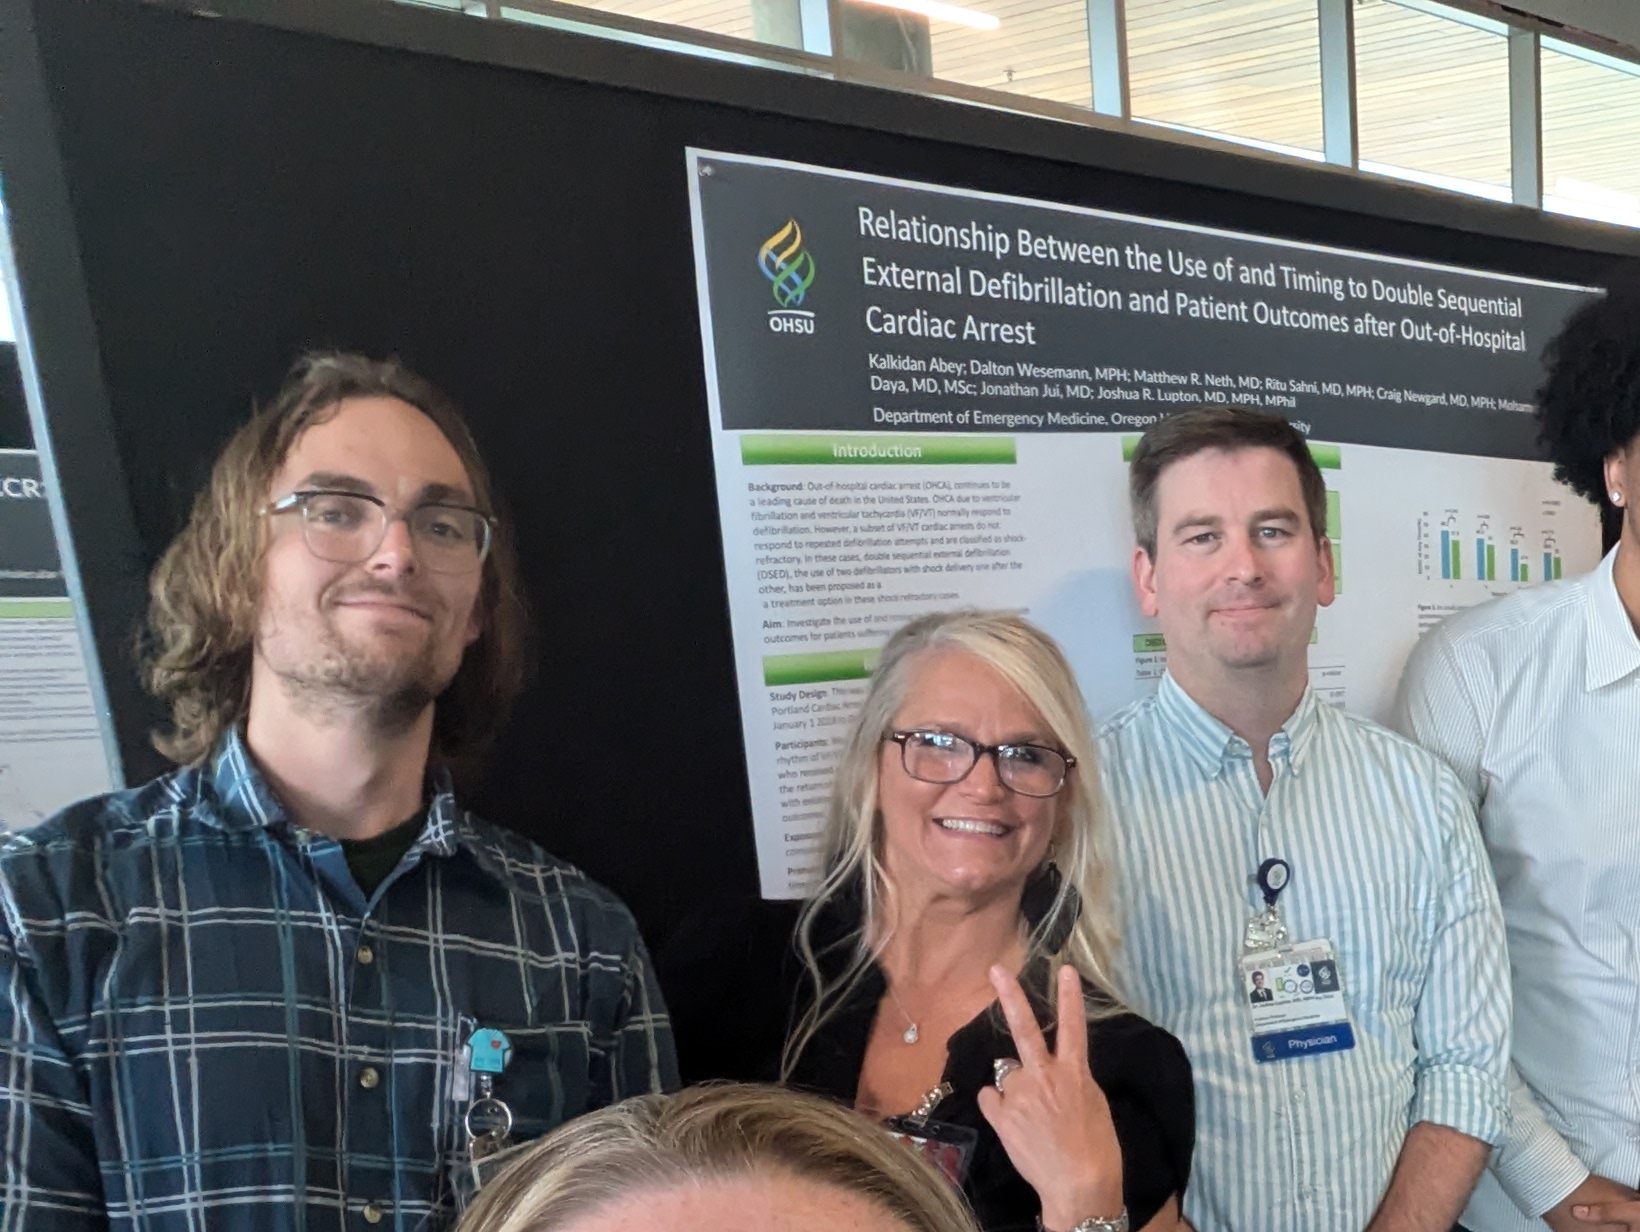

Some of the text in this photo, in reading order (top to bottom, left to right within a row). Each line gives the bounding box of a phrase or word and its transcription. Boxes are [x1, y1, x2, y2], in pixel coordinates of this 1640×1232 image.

[858, 206, 1522, 318] Relationship Between the Use of and Timing to Double Sequential
[862, 257, 1526, 352] External Defibrillation and Patient Outcomes after Out-of-Hospital
[769, 316, 815, 334] OHSU
[866, 306, 1036, 344] Cardiac Arrest
[869, 353, 926, 371] Kalkidan
[970, 360, 1014, 376] Dalton
[1017, 362, 1092, 381] Wesemann,
[1095, 367, 1131, 382] MPH;
[1134, 369, 1187, 385] Matthew
[1190, 373, 1202, 386] R.
[1205, 374, 1236, 388] Neth,
[1239, 377, 1263, 390] MD;
[1265, 378, 1286, 391] Ritu
[1289, 379, 1319, 395] Sahni,
[1322, 382, 1344, 397] MD,
[1346, 385, 1375, 399] MPH;
[1377, 387, 1401, 403] Craig
[1404, 390, 1447, 406] Newgard,
[1450, 394, 1469, 408] MD,
[871, 376, 1296, 408] Daya, MD, MSc; Jonathan Jui, MD; Joshua R. Lupton, MD, MPH, MPhil
[873, 408, 953, 426] Department
[956, 411, 969, 424] of
[974, 411, 1044, 427] Emergency
[1047, 412, 1108, 426] Medicine,
[1111, 413, 1157, 428] Oregon
[833, 443, 921, 458] Introduction
[770, 692, 796, 702] Study
[771, 704, 809, 715] Portland
[1287, 1035, 1337, 1049] Physician
